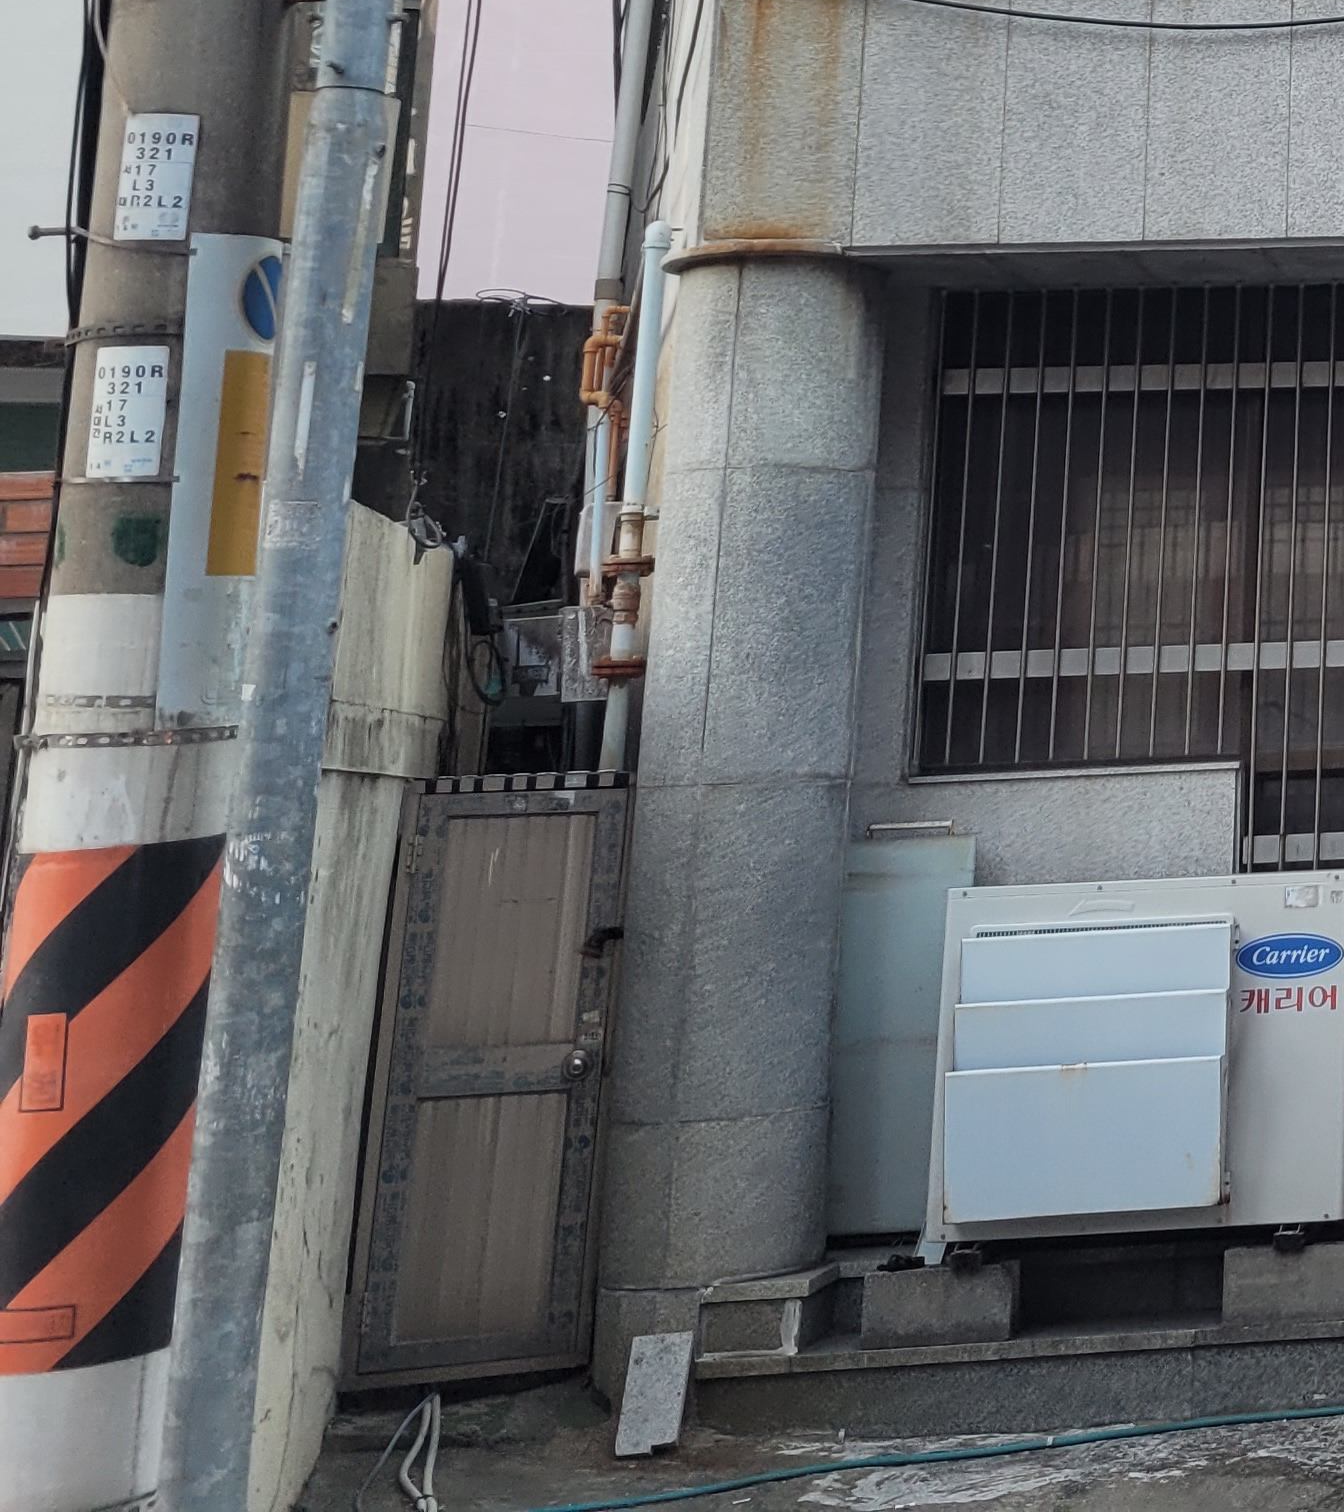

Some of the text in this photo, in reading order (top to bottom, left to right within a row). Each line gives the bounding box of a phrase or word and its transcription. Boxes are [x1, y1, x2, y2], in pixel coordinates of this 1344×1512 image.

[127, 131, 194, 146] 0190R
[135, 146, 173, 161] 321
[135, 163, 157, 176] 17
[132, 178, 155, 192] L3
[98, 364, 164, 379] 0190R
[107, 380, 143, 395] 321
[106, 398, 128, 412] 17
[104, 414, 127, 428] L3
[1252, 944, 1330, 966] Carrier
[1240, 984, 1338, 1014] 캐리어
